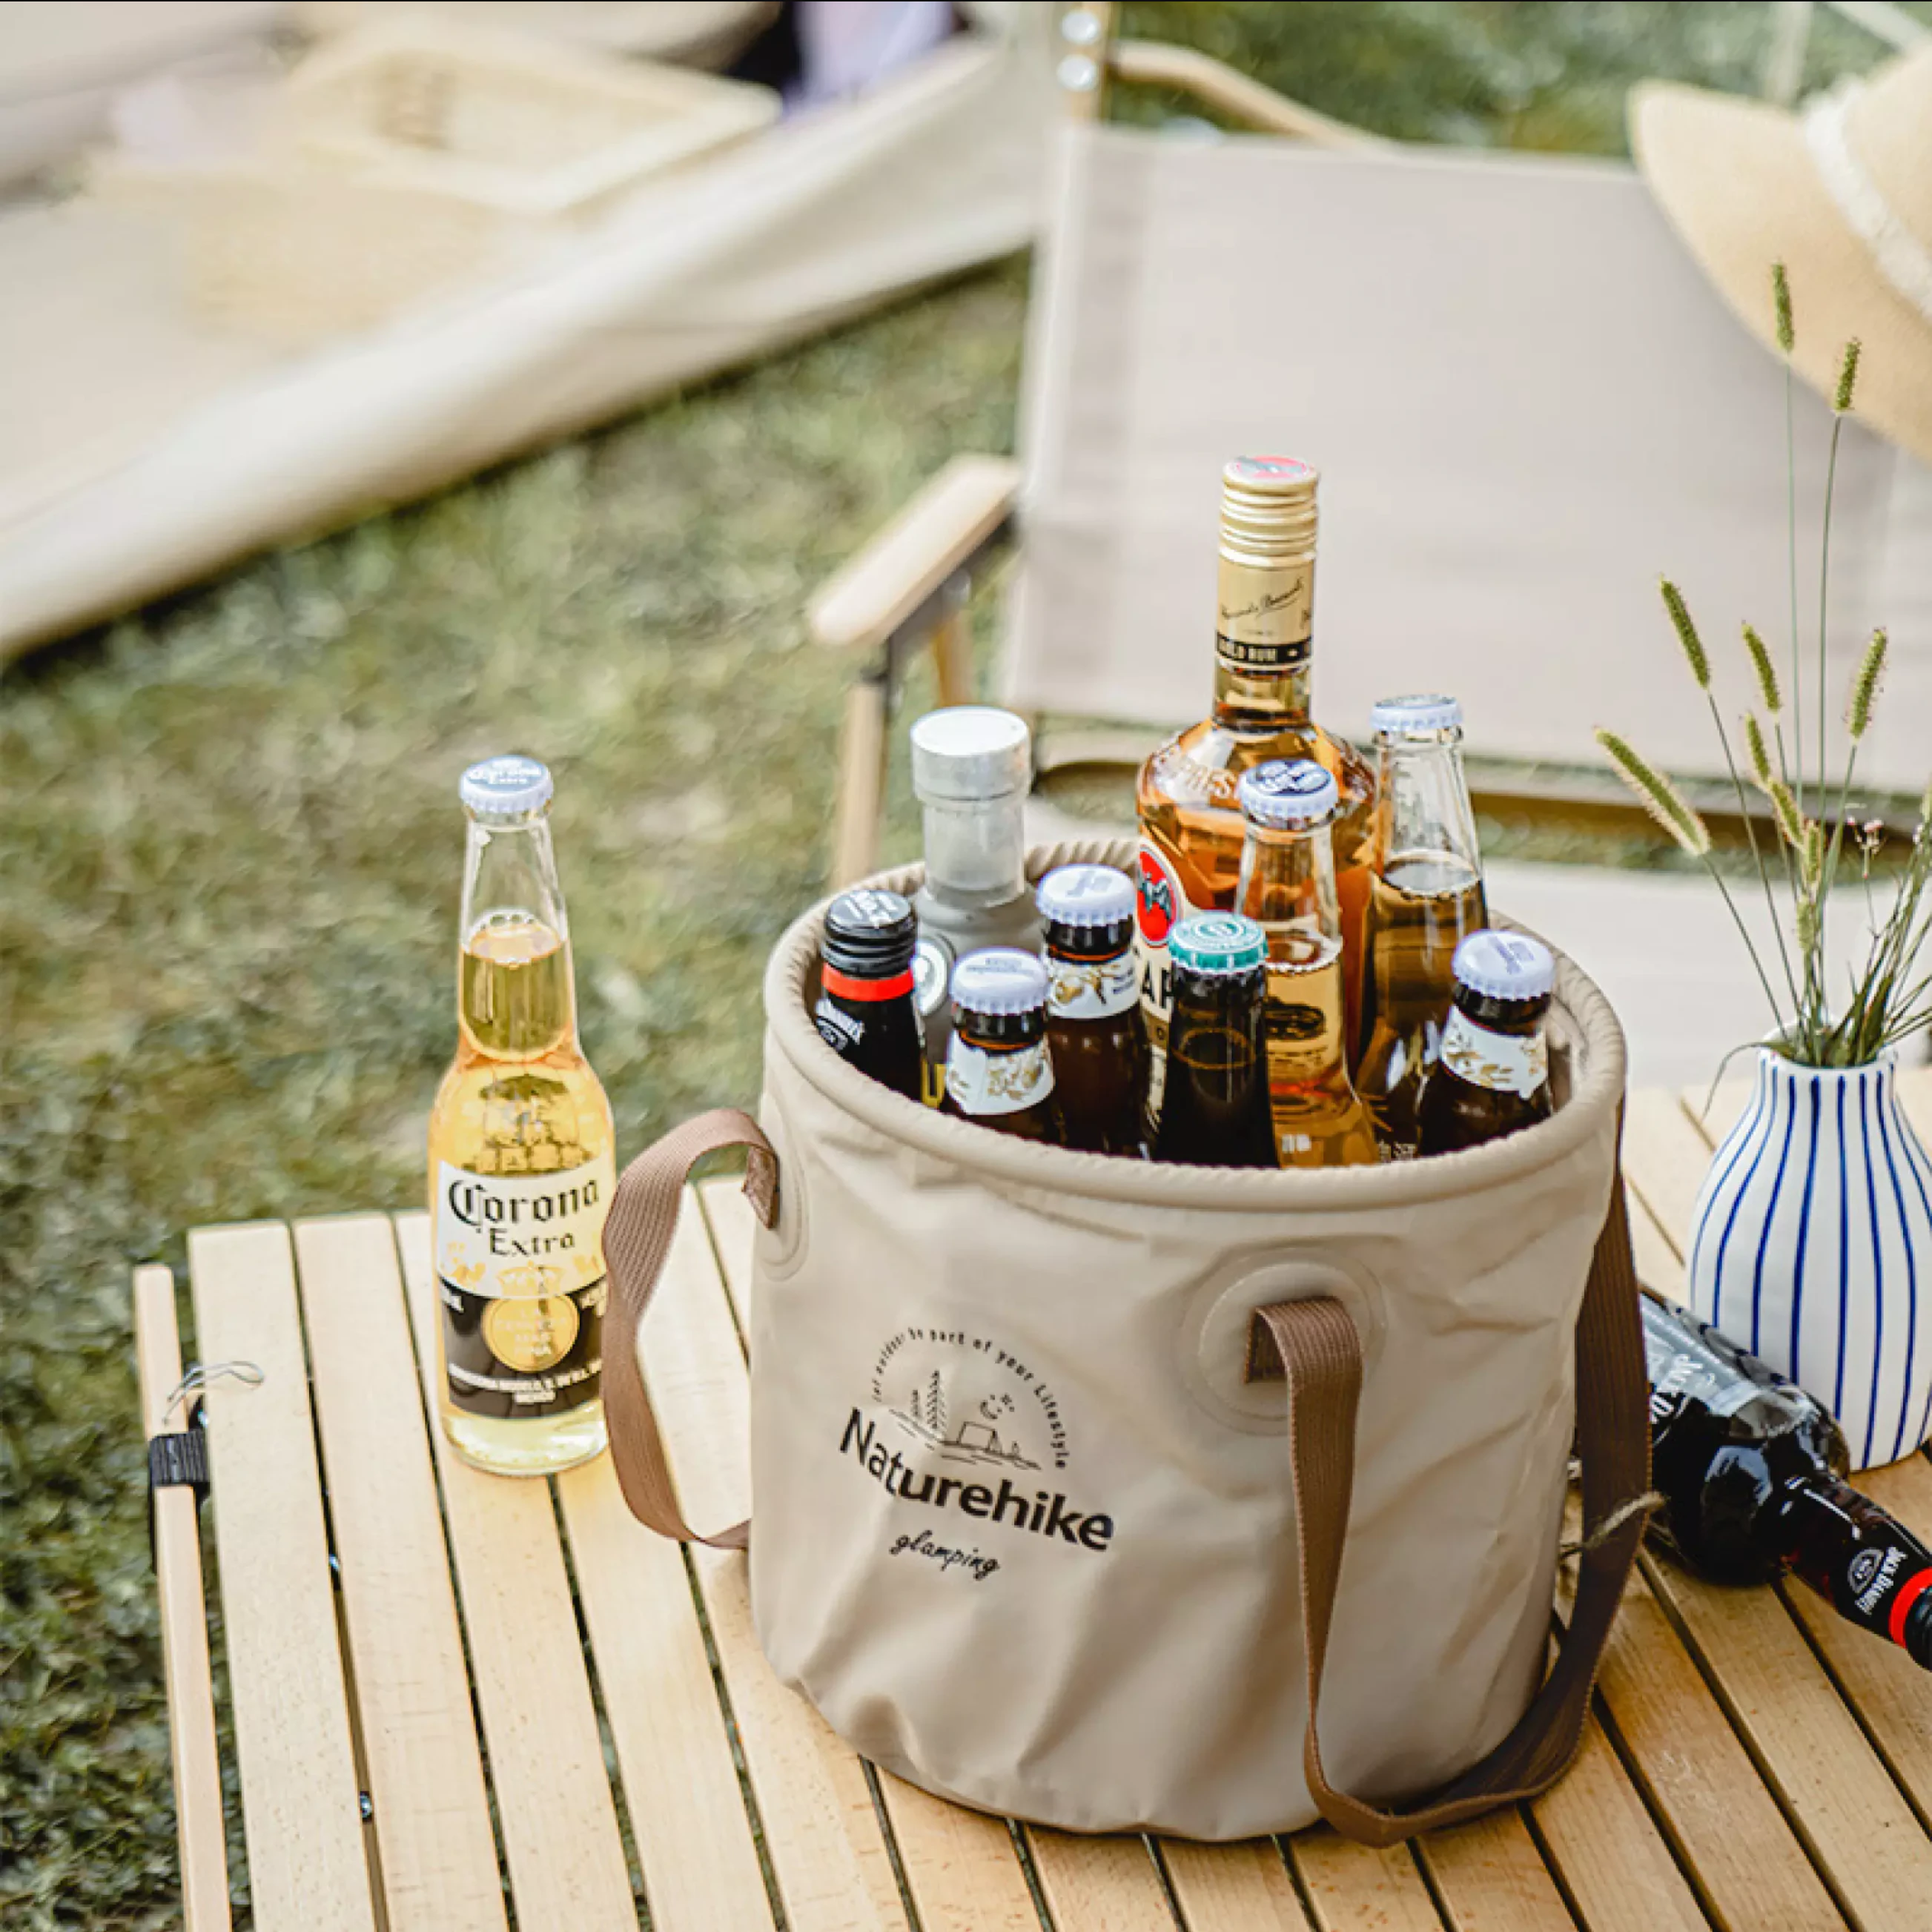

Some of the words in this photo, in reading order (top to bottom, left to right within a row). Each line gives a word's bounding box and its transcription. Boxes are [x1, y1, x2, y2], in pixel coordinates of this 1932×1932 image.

[449, 1179, 599, 1234] Corona
[489, 1227, 575, 1256] Extra
[839, 1406, 1114, 1552] Naturehike
[889, 1529, 1001, 1581] glamping
